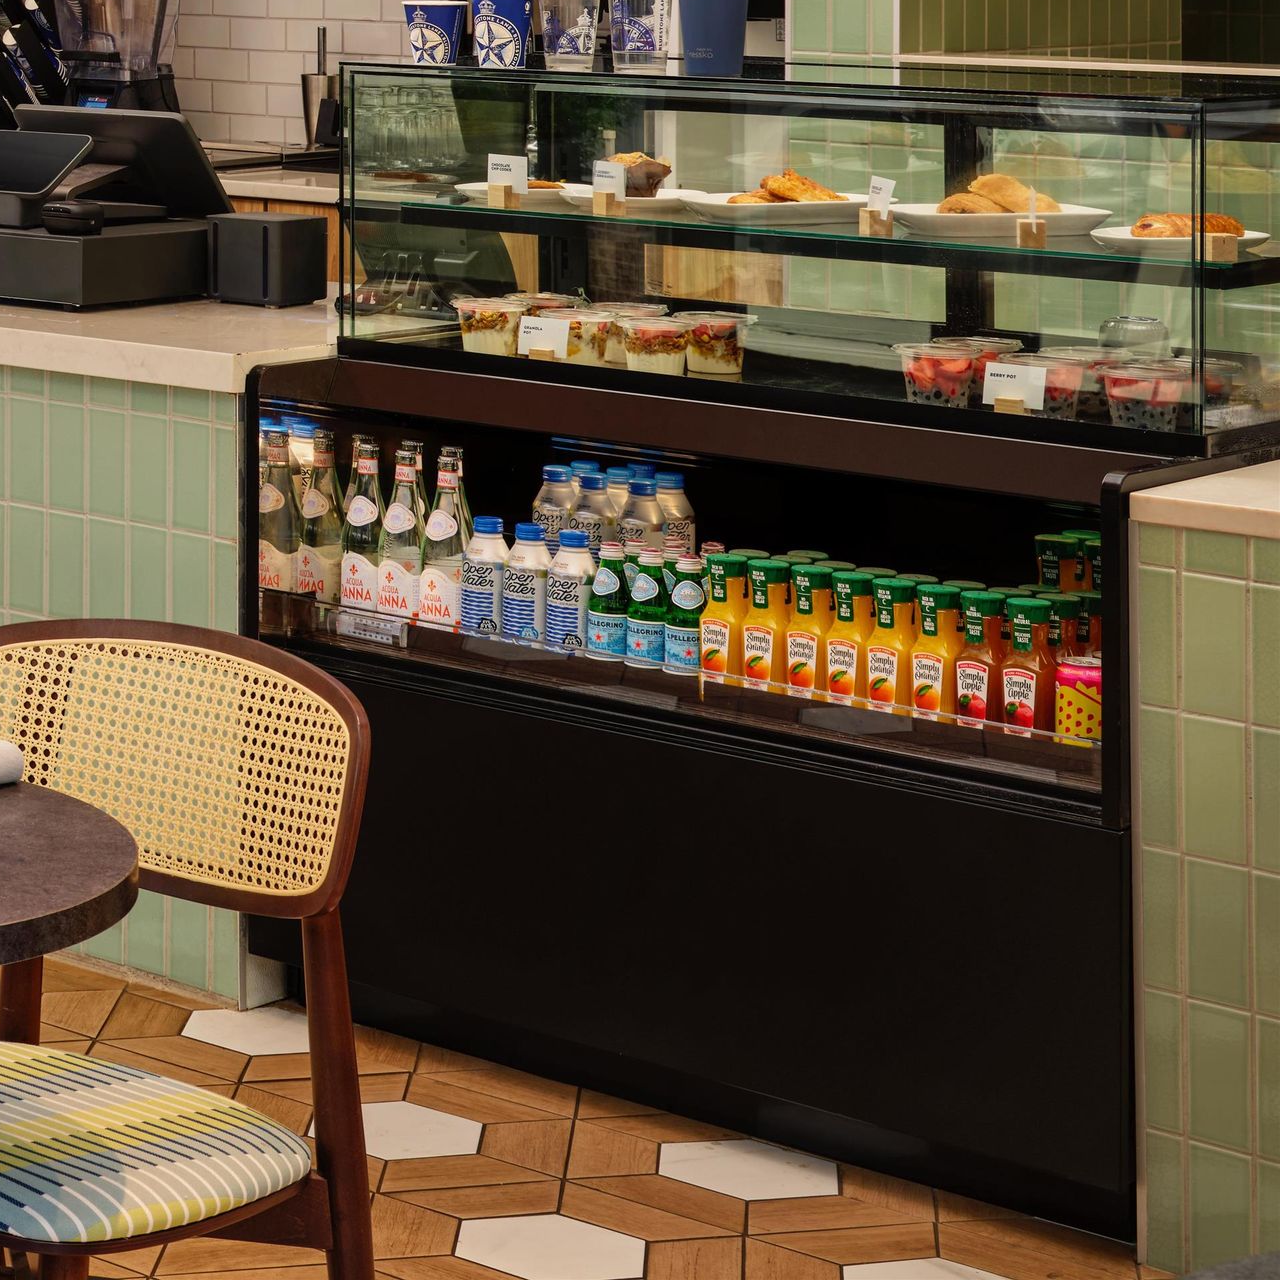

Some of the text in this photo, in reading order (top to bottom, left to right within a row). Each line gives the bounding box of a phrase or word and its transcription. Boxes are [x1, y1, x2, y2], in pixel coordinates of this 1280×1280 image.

[496, 17, 511, 31] LANE
[569, 517, 601, 533] Open
[462, 561, 493, 578] Open
[504, 568, 535, 585] Open
[346, 577, 363, 588] ACQUA
[381, 584, 399, 595] ACQUA
[548, 576, 578, 593] Open
[703, 626, 727, 641] Simply
[745, 631, 770, 647] Simply
[702, 637, 727, 649] Orange
[745, 643, 770, 655] Orange
[789, 638, 814, 653] Simply
[789, 649, 815, 662] Orange
[829, 646, 854, 661] Simply
[869, 653, 894, 668] Simply
[829, 656, 854, 670] Orange
[869, 664, 895, 676] Orange
[915, 660, 940, 675] Simply
[914, 671, 940, 686] Orange
[959, 669, 985, 685] Simply
[1005, 676, 1033, 693] Simply
[961, 680, 982, 696] Apple
[1007, 688, 1030, 704] Apple
